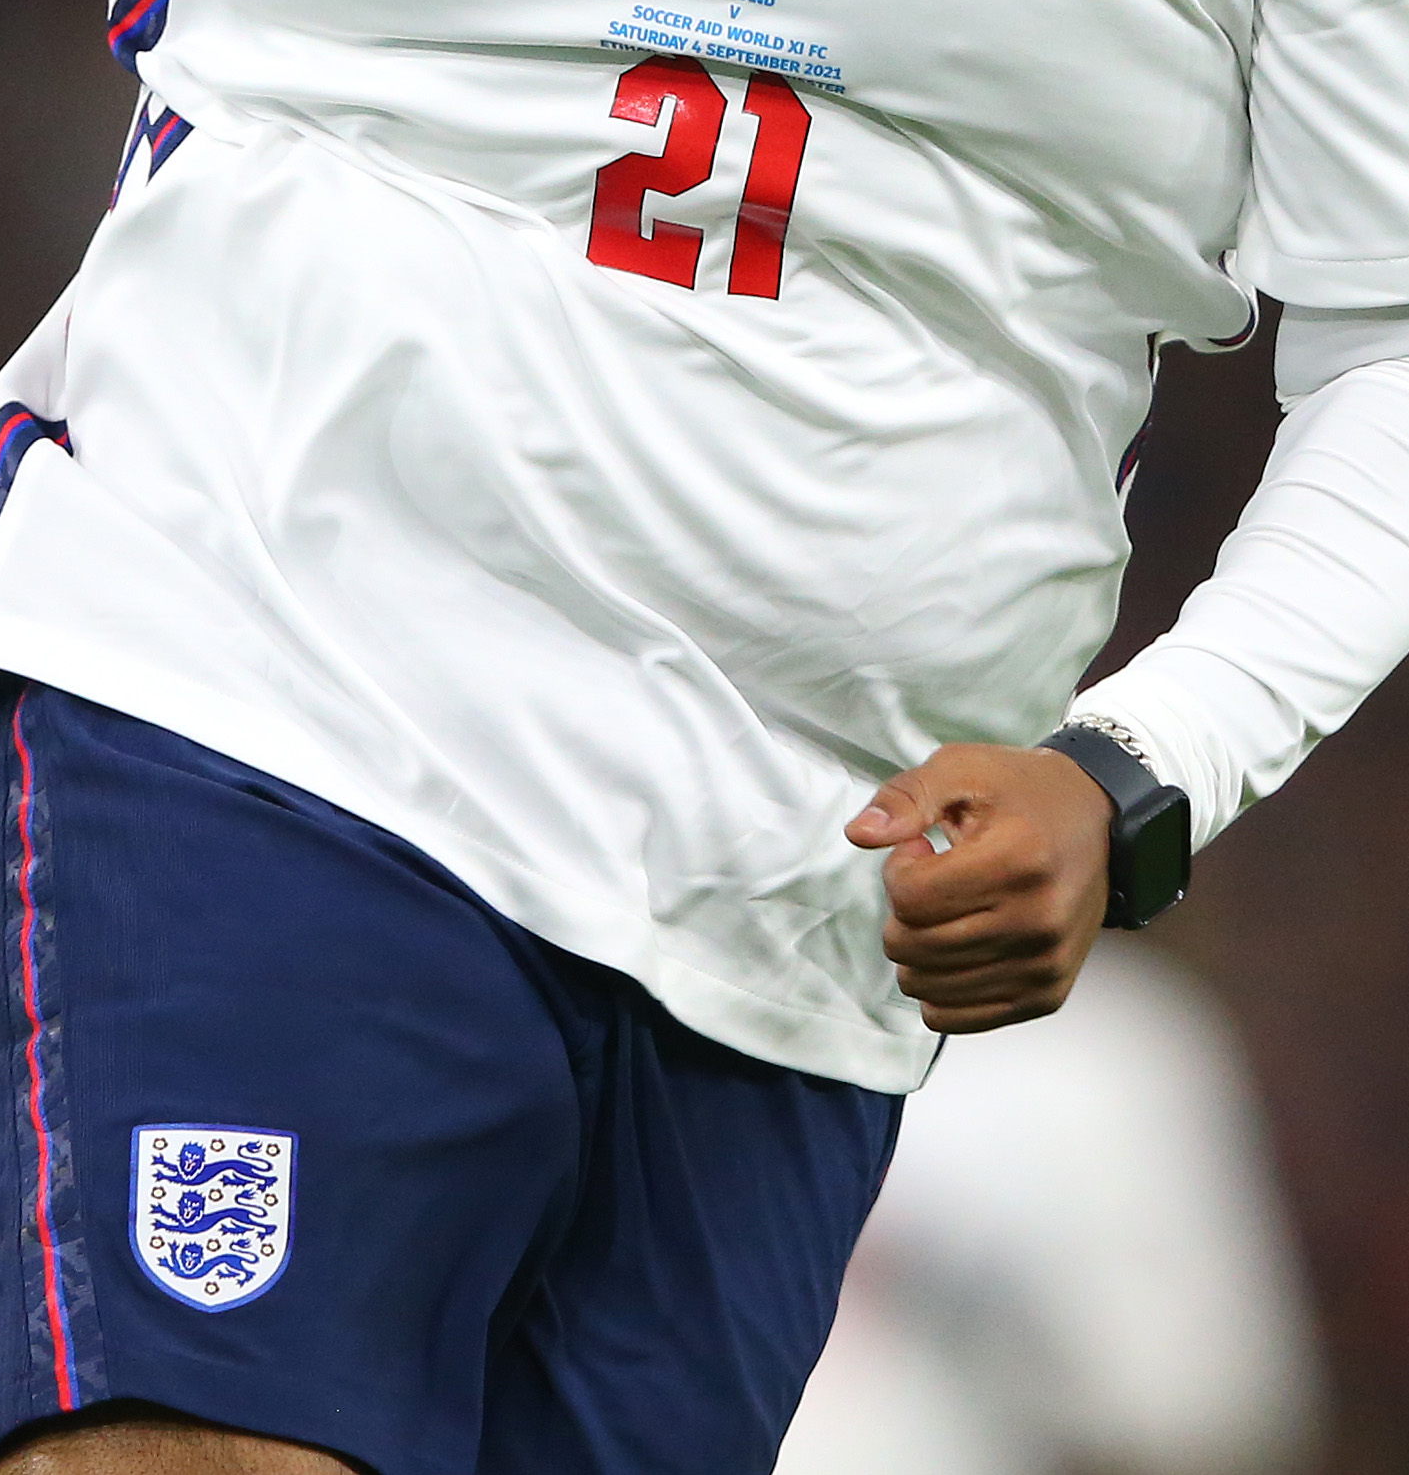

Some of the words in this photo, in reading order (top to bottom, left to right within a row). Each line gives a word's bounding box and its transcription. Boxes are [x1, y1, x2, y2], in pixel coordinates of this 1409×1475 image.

[608, 21, 688, 50] SATURDAY
[691, 40, 701, 53] 4
[706, 43, 800, 73] SEPTEMBER
[804, 63, 841, 80] 2021
[632, 4, 692, 30] SOCCER
[695, 19, 723, 36] AID
[727, 25, 784, 50] WORLD
[788, 39, 805, 55] XI
[808, 44, 828, 59] FC
[586, 54, 812, 301] 21
